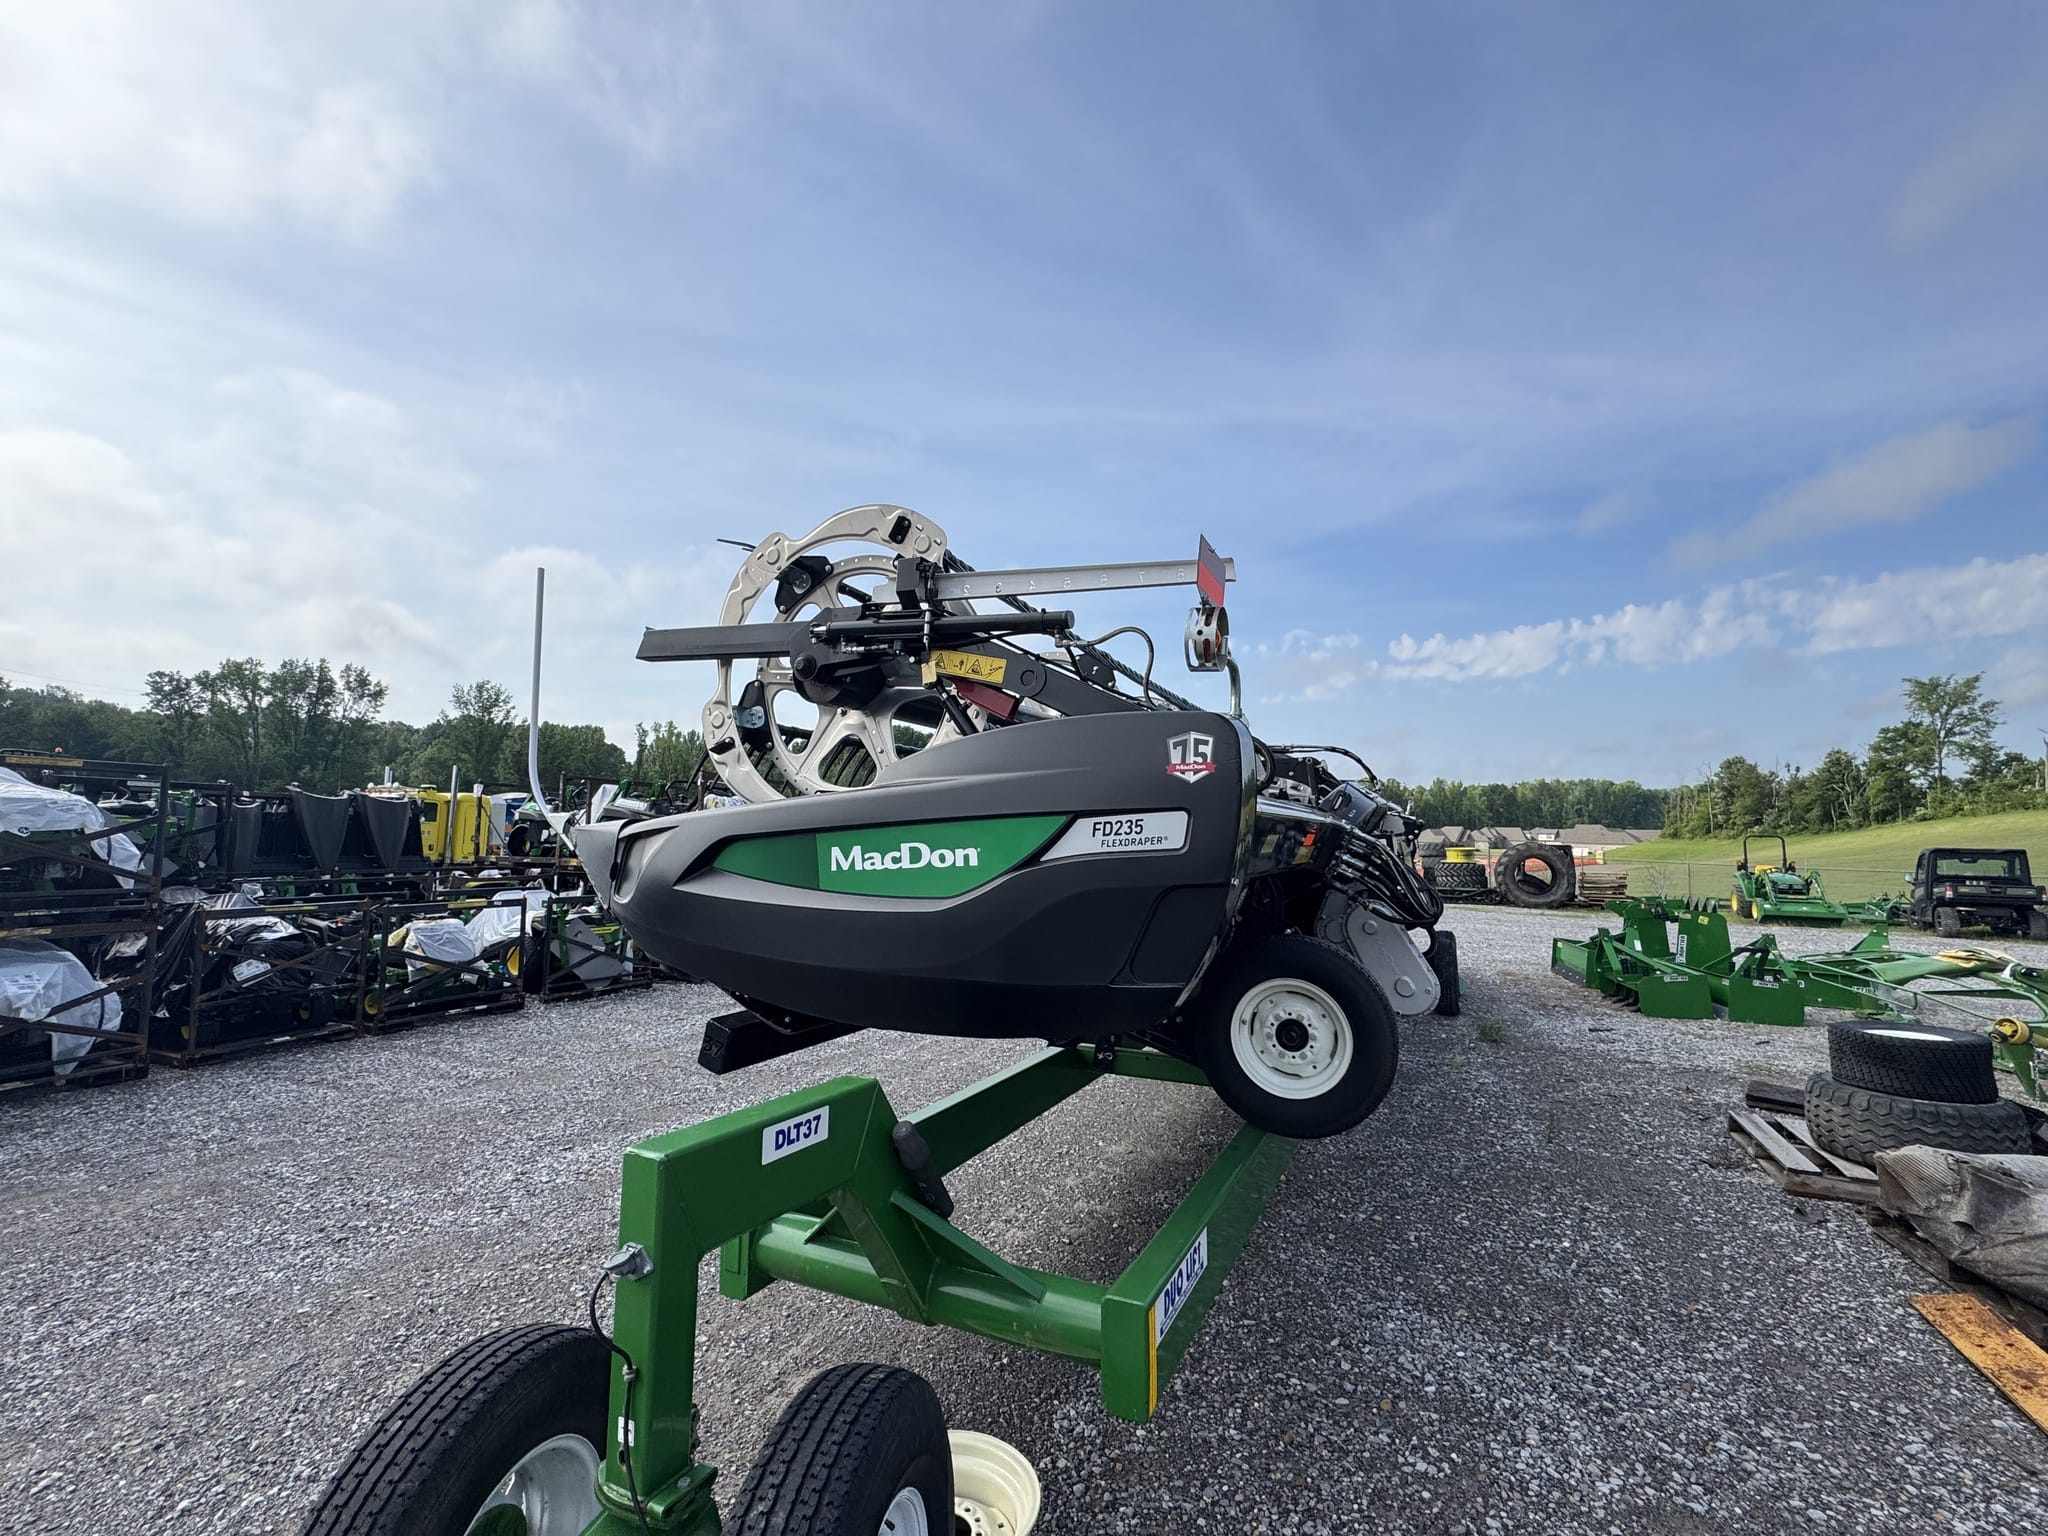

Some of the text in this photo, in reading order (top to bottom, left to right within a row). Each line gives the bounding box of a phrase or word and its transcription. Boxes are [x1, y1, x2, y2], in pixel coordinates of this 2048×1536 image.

[1092, 818, 1144, 838] FD235
[774, 1113, 822, 1151] DLT37
[1163, 1241, 1202, 1319] DUO LIFT
